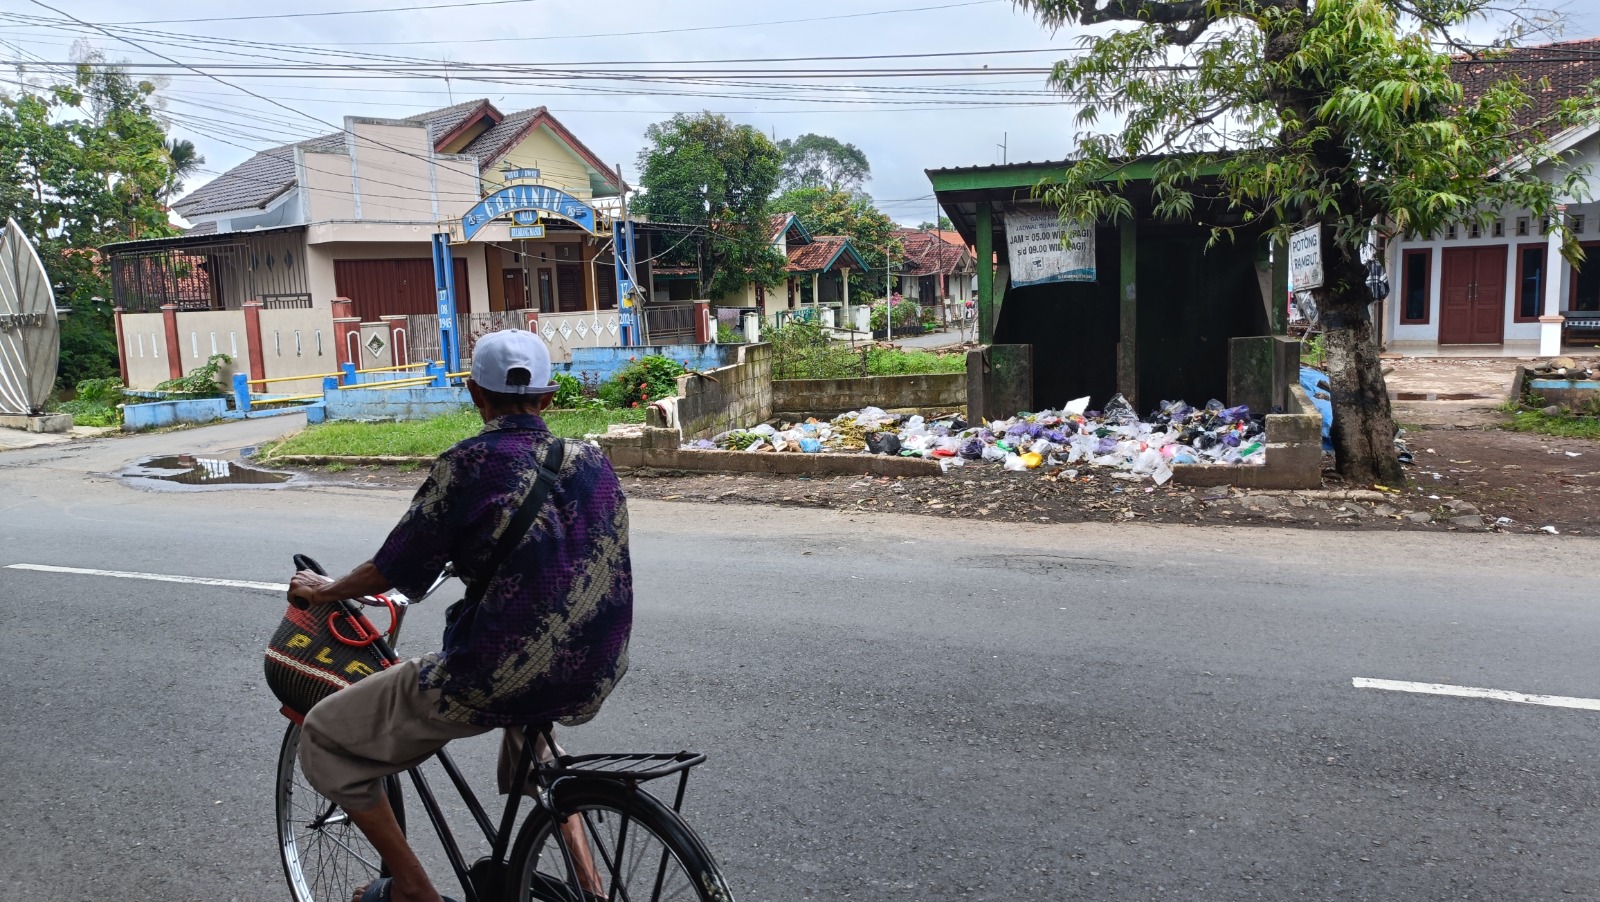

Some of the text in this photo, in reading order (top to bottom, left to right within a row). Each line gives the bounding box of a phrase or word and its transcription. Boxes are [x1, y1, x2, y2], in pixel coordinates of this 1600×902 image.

[1016, 224, 1038, 232] JADWAL
[1010, 234, 1024, 244] JAM
[1032, 232, 1050, 242] 05.00
[1292, 234, 1317, 253] POTONG
[1028, 244, 1047, 254] 09.00
